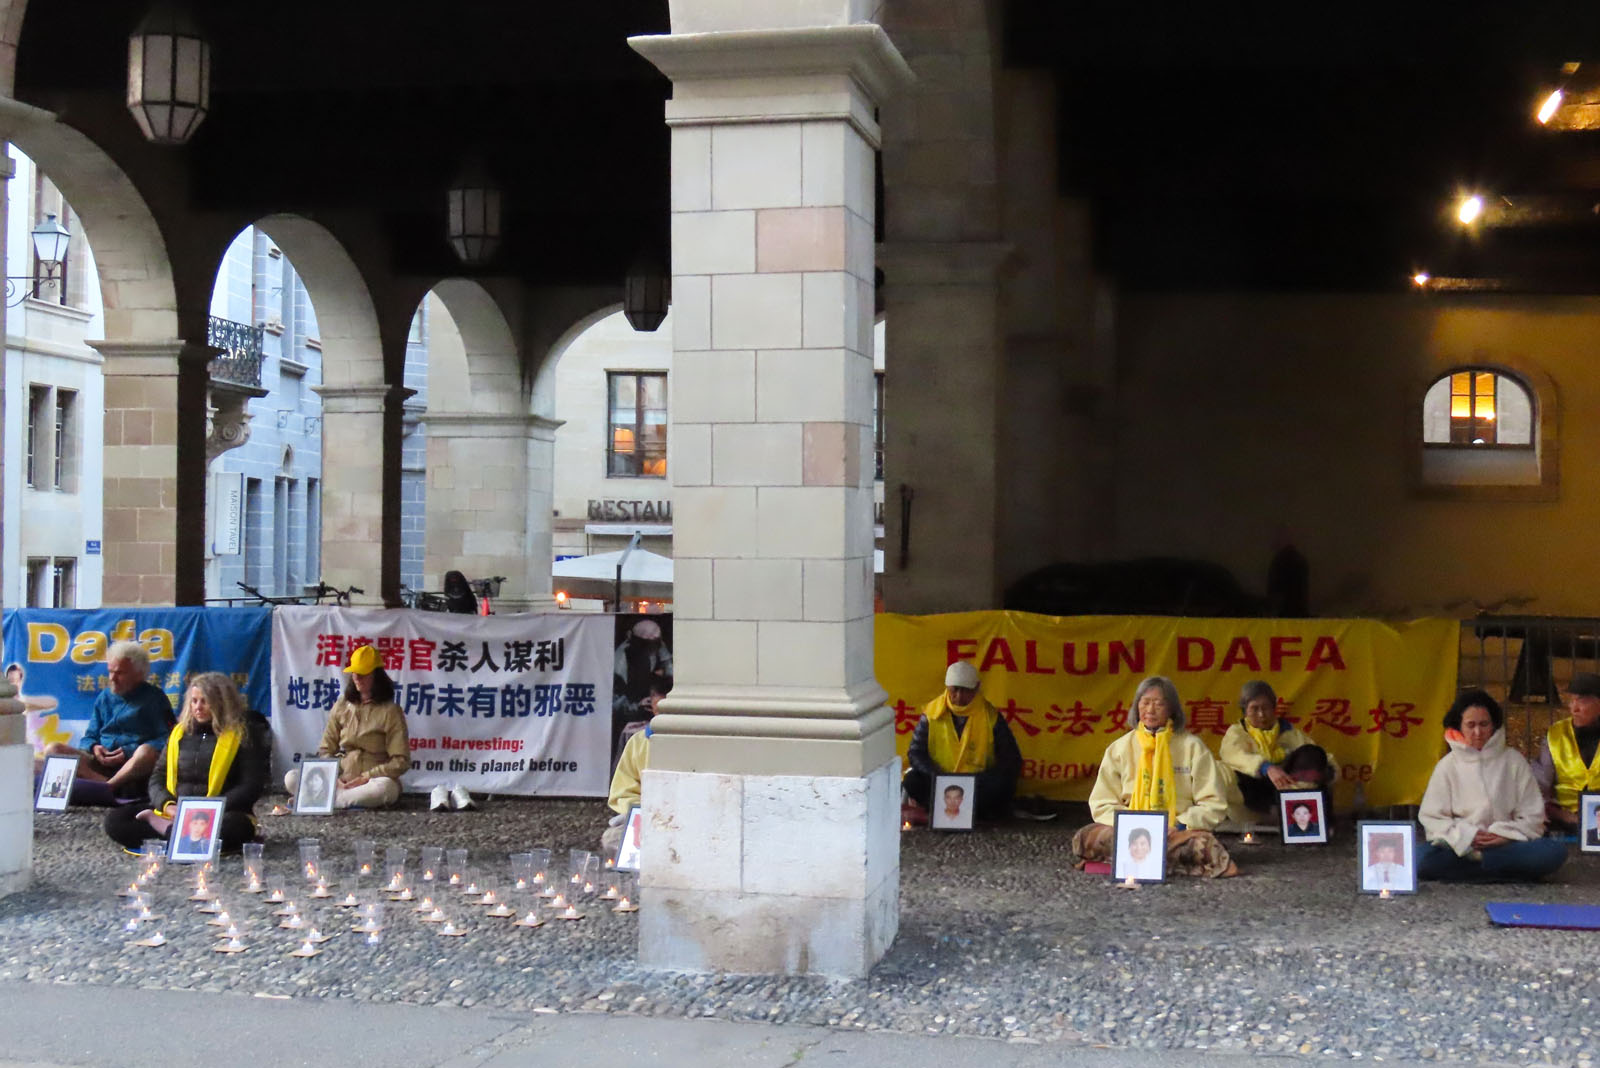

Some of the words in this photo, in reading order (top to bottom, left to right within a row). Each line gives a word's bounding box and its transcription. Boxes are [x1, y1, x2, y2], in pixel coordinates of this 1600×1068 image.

[229, 490, 238, 525] MAISON
[587, 499, 673, 521] RESTAU
[228, 527, 237, 552] TAVEL
[27, 619, 175, 664] Dafa
[946, 637, 1146, 677] FALUN
[1177, 635, 1346, 673] DAFA
[286, 675, 596, 718] 地球所未有的邪恶
[409, 737, 437, 752] gan
[441, 736, 524, 753] Harvesting:
[426, 759, 444, 772] on
[449, 758, 476, 773] this
[480, 758, 525, 775] planet
[529, 758, 578, 772] before
[1021, 758, 1100, 780] Bienv
